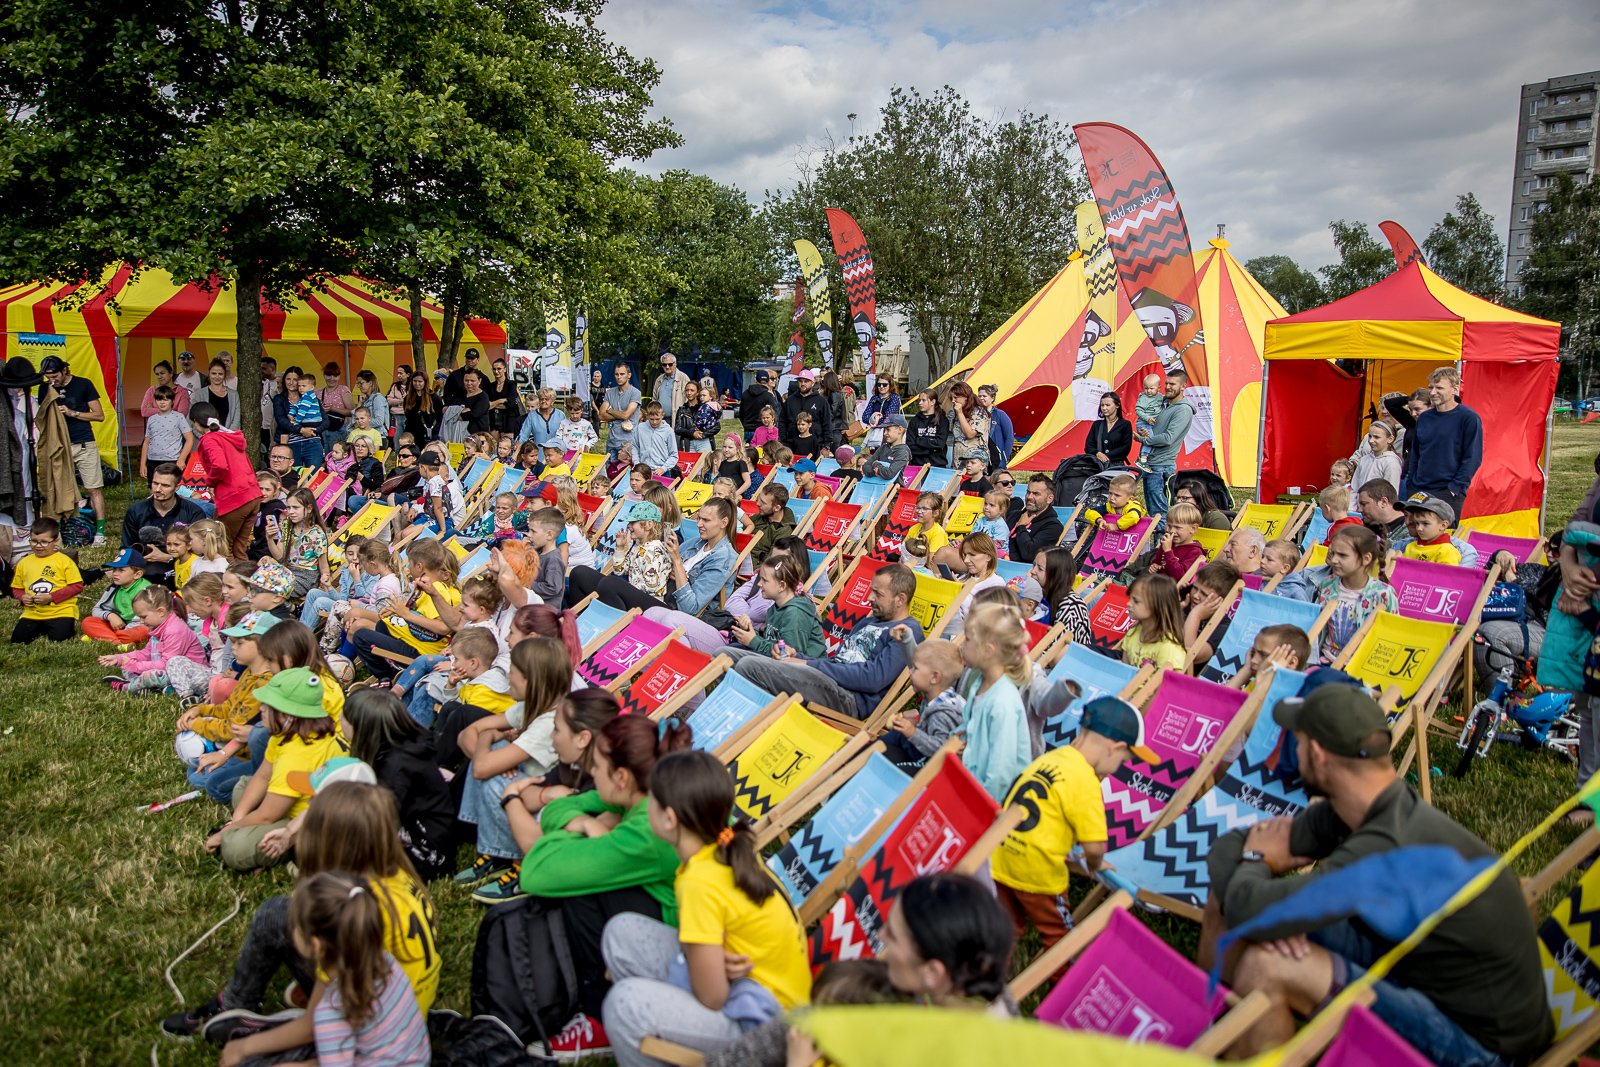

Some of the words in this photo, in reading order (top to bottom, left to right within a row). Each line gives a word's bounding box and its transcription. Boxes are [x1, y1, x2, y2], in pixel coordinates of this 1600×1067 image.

[1425, 588, 1460, 617] JCK
[1389, 648, 1426, 678] JCK
[1181, 716, 1221, 755] JCK
[772, 750, 811, 786] JCK
[1127, 772, 1153, 796] Skok
[1235, 783, 1264, 808] Skok
[1554, 939, 1590, 984] Skok
